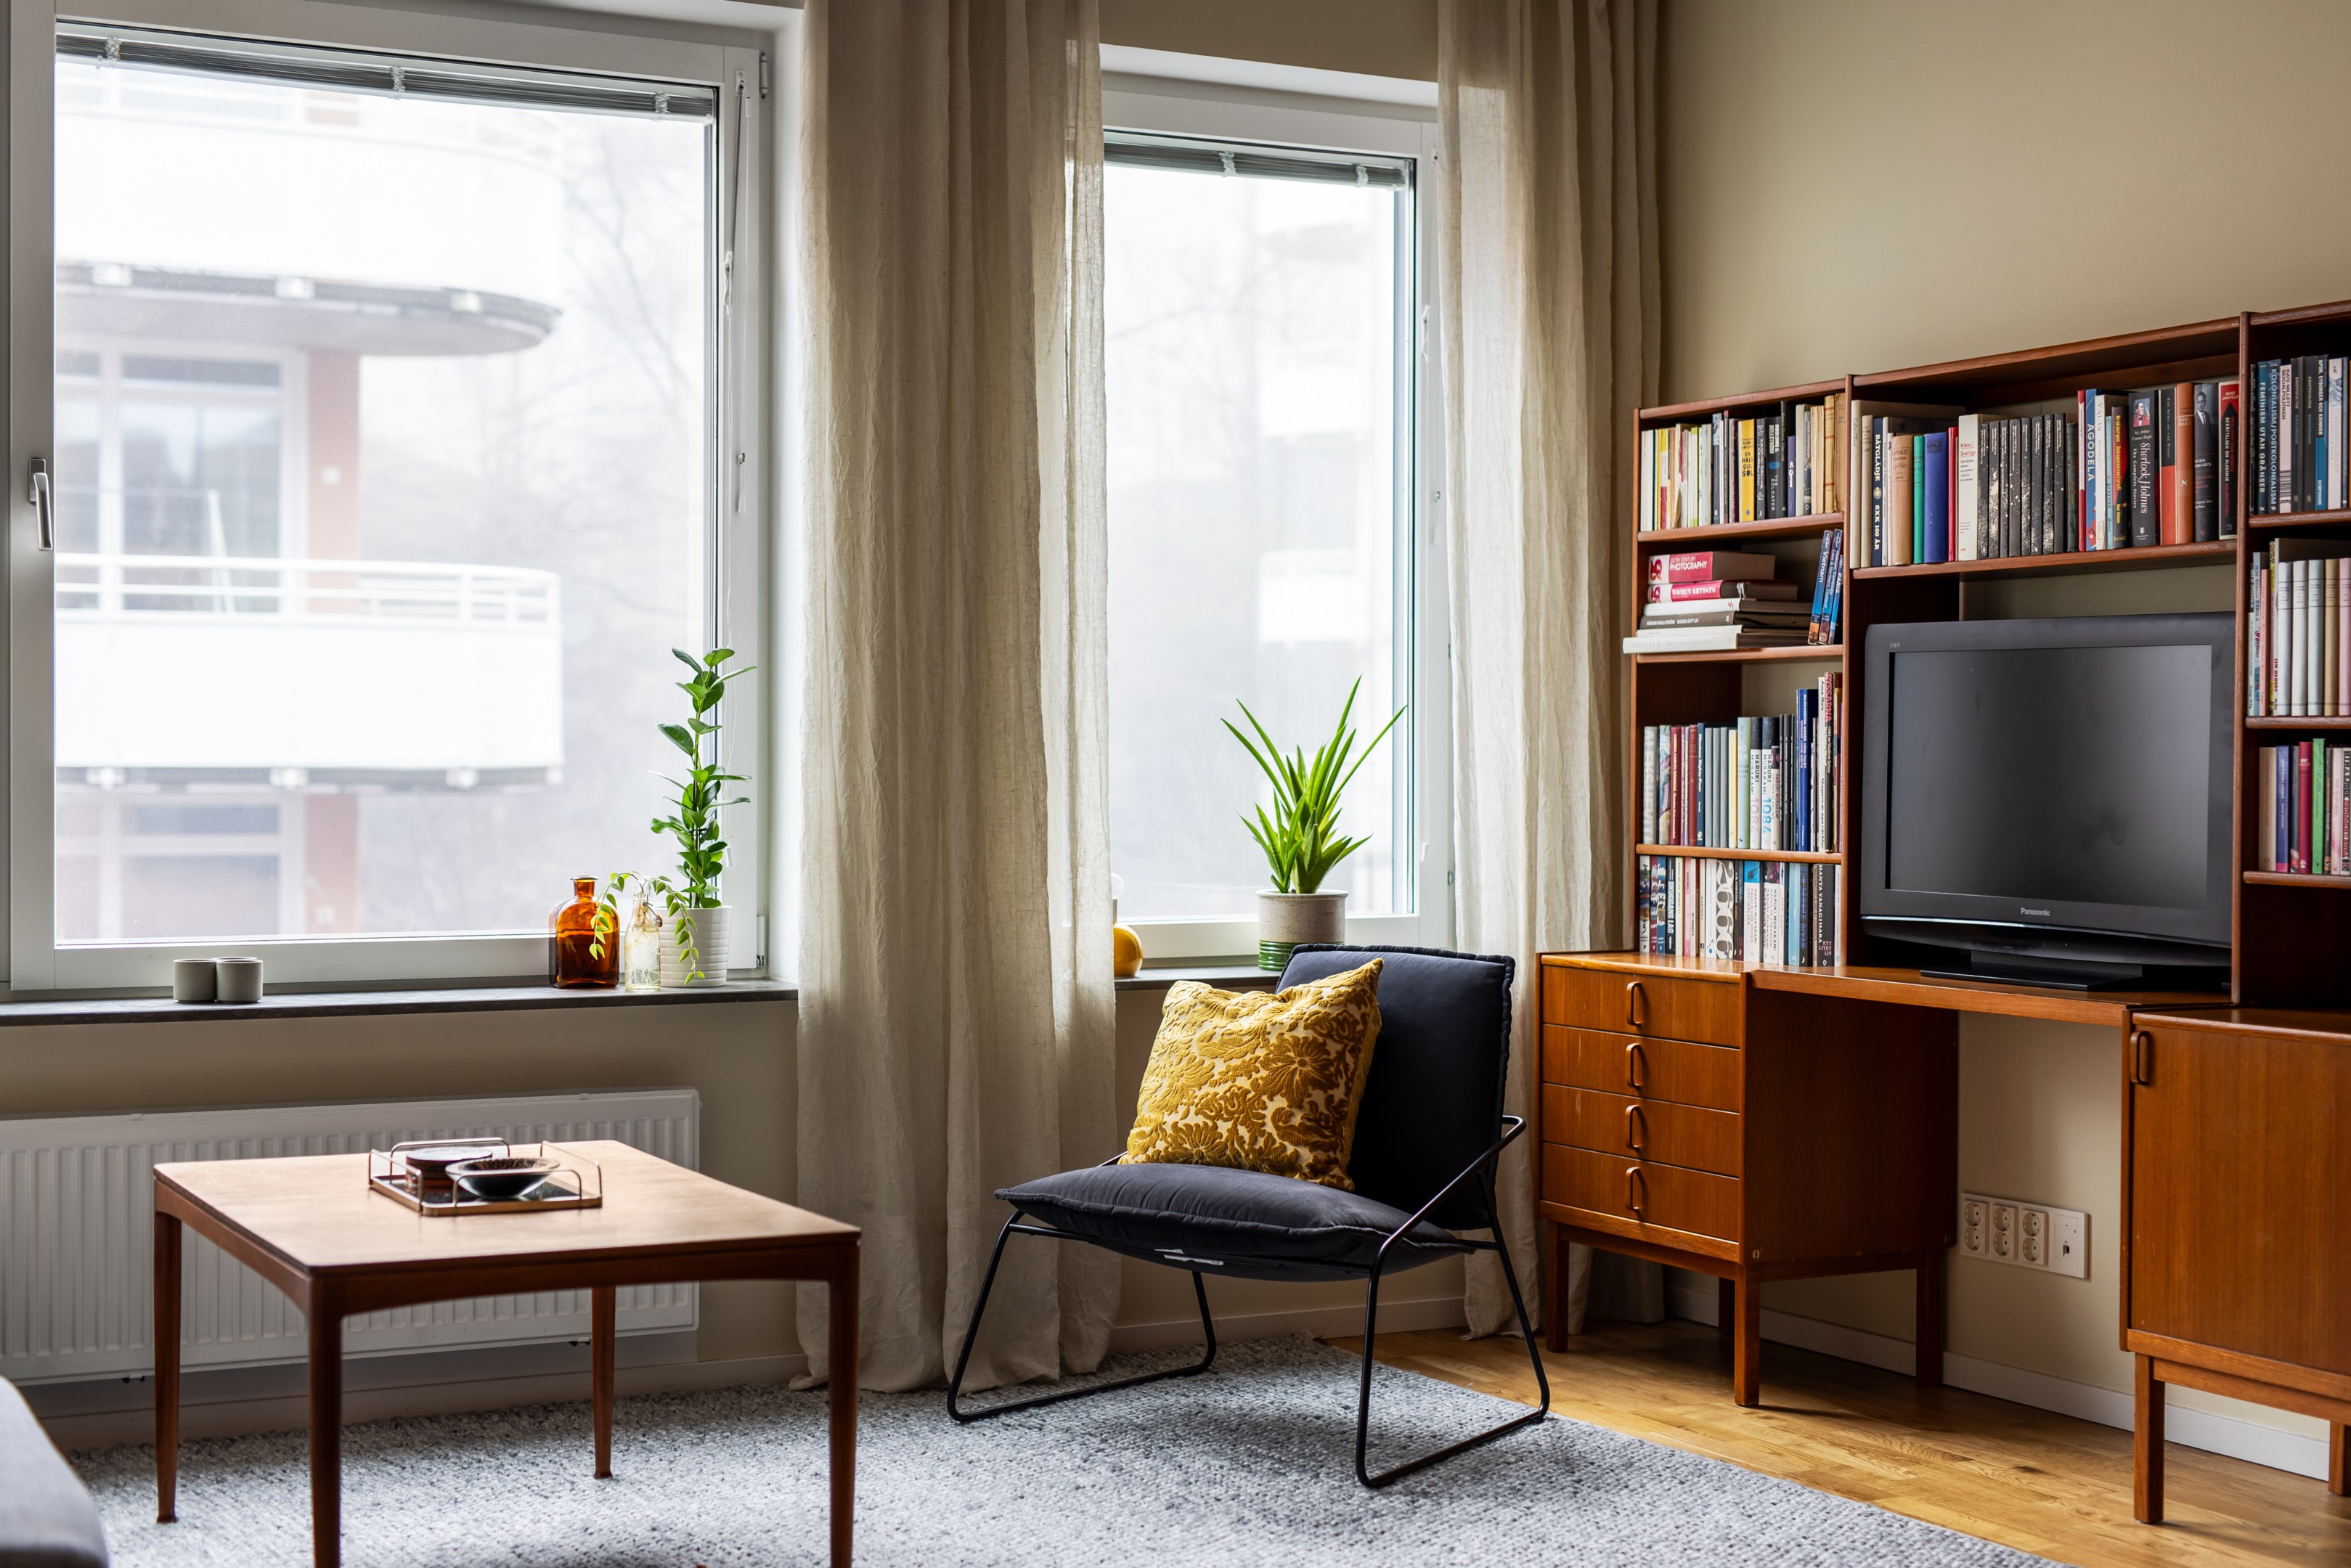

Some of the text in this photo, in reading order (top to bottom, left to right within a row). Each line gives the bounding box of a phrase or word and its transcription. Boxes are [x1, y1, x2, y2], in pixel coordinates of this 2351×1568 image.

[2138, 442, 2151, 514] Sherlock Holmes
[1874, 538, 1881, 550] ÅR
[1669, 560, 1708, 571] PHOTOGRAPHY
[1819, 550, 1828, 583] Vietnam
[1762, 797, 1772, 834] 1Q84
[1716, 861, 1735, 960] 2666
[2021, 907, 2050, 916] Panasonic
